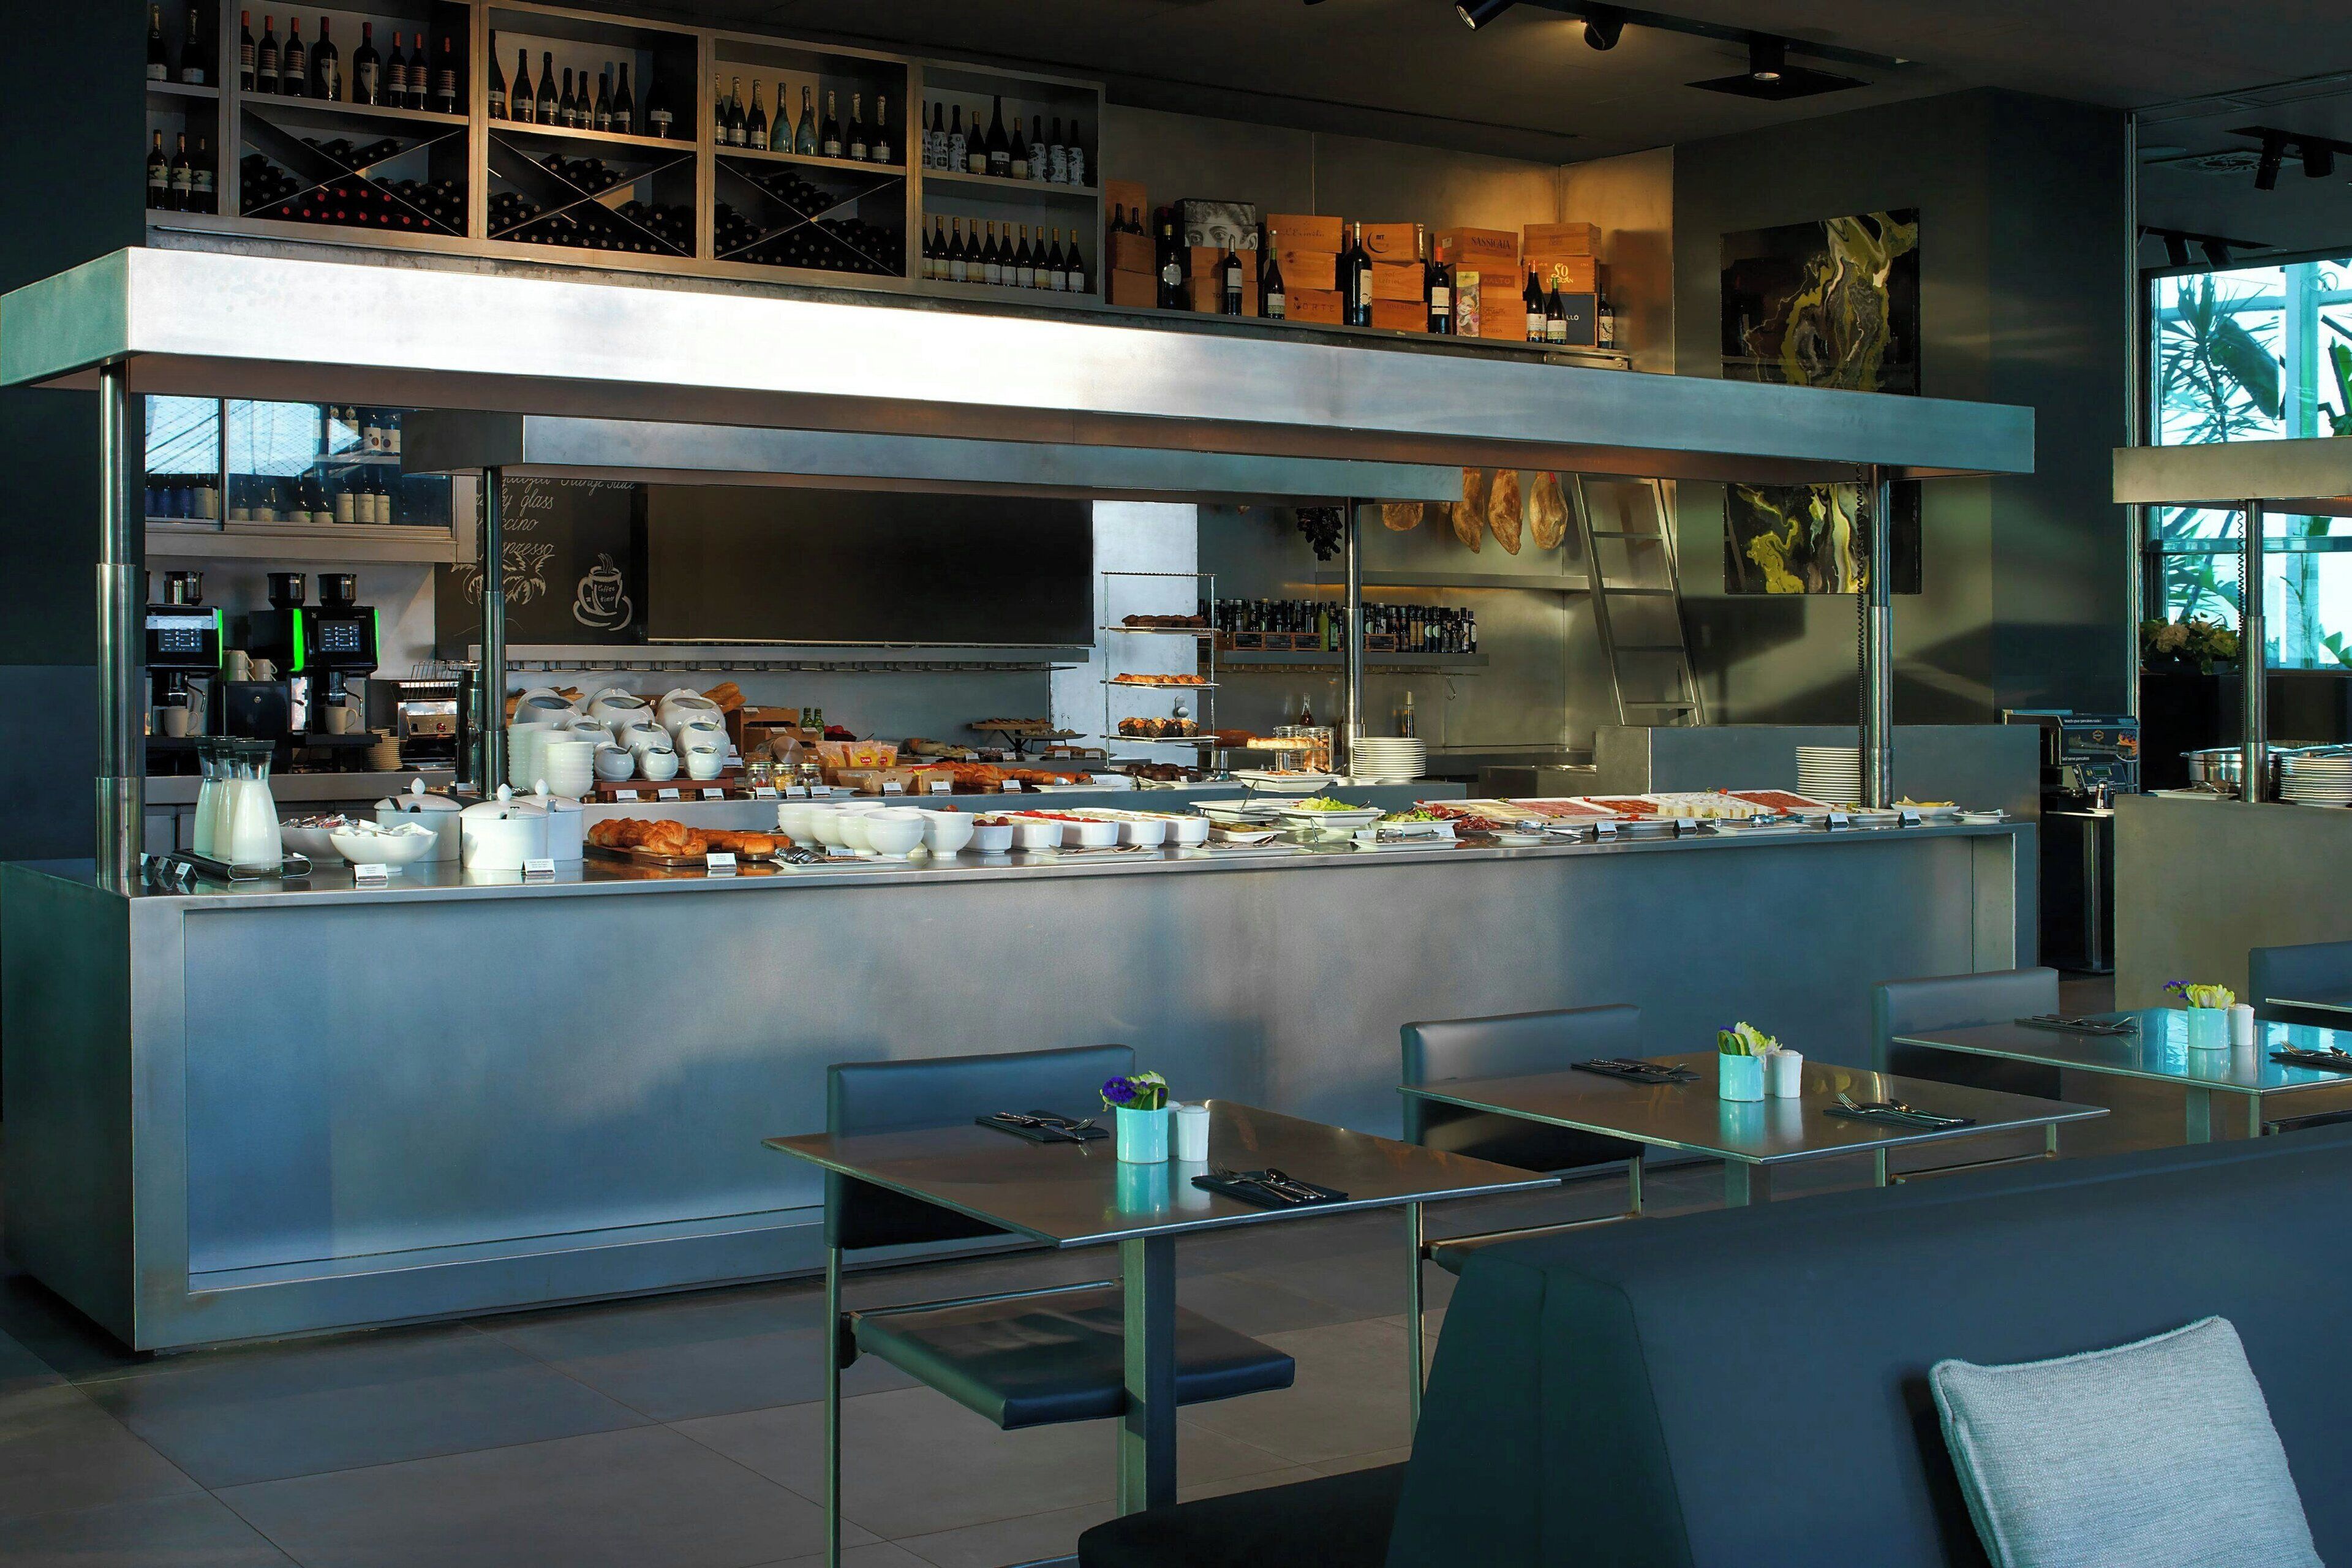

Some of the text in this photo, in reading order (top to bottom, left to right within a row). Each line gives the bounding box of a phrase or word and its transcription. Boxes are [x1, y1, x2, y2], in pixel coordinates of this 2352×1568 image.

[1471, 236, 1510, 249] SASSICAIA
[520, 488, 554, 516] glass
[502, 541, 554, 557] spresso
